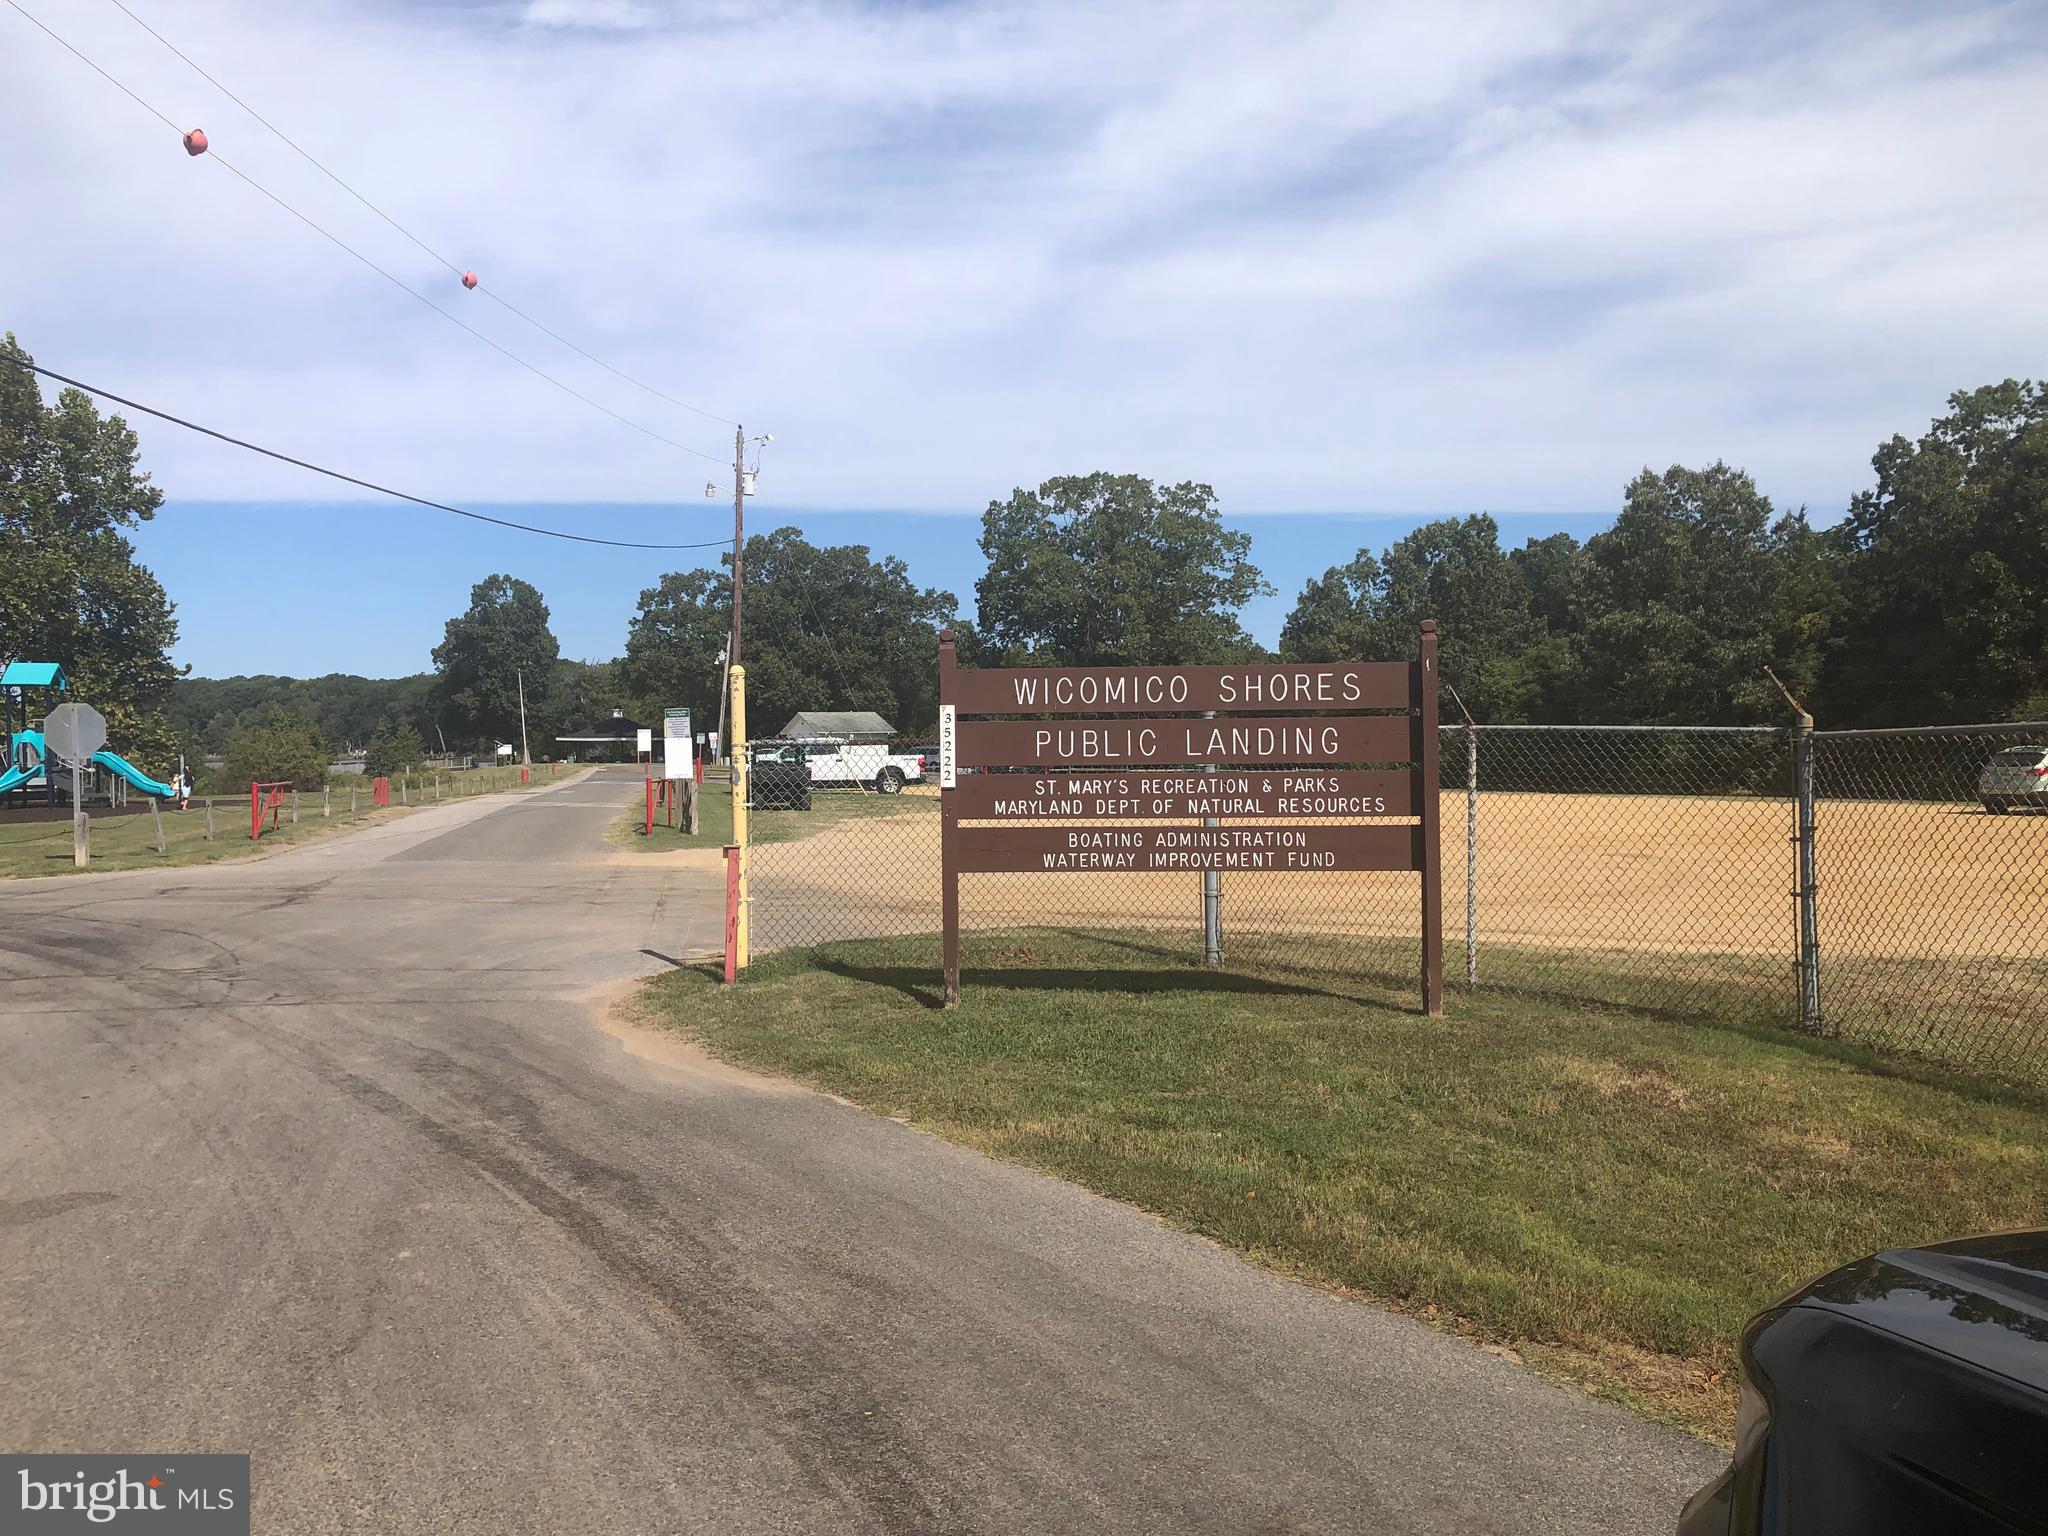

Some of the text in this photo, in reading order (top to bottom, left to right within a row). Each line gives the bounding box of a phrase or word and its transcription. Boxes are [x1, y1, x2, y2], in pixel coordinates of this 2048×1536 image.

[1014, 672, 1361, 705] WICOMICO SHORES
[944, 713, 952, 781] 35222
[1036, 726, 1338, 758] PUBLIC LANDING
[1034, 777, 1340, 796] ST. MARY'S RECREATION & PARKS
[994, 799, 1083, 815] MARYLAND
[1152, 798, 1174, 815] OF
[1188, 798, 1265, 814] NATURAL
[1278, 797, 1386, 813] RESOURCES
[1068, 831, 1306, 849] BOATING ADMINISTRATION
[1043, 851, 1335, 868] WATERWAY IMPROVEMENT FUND
